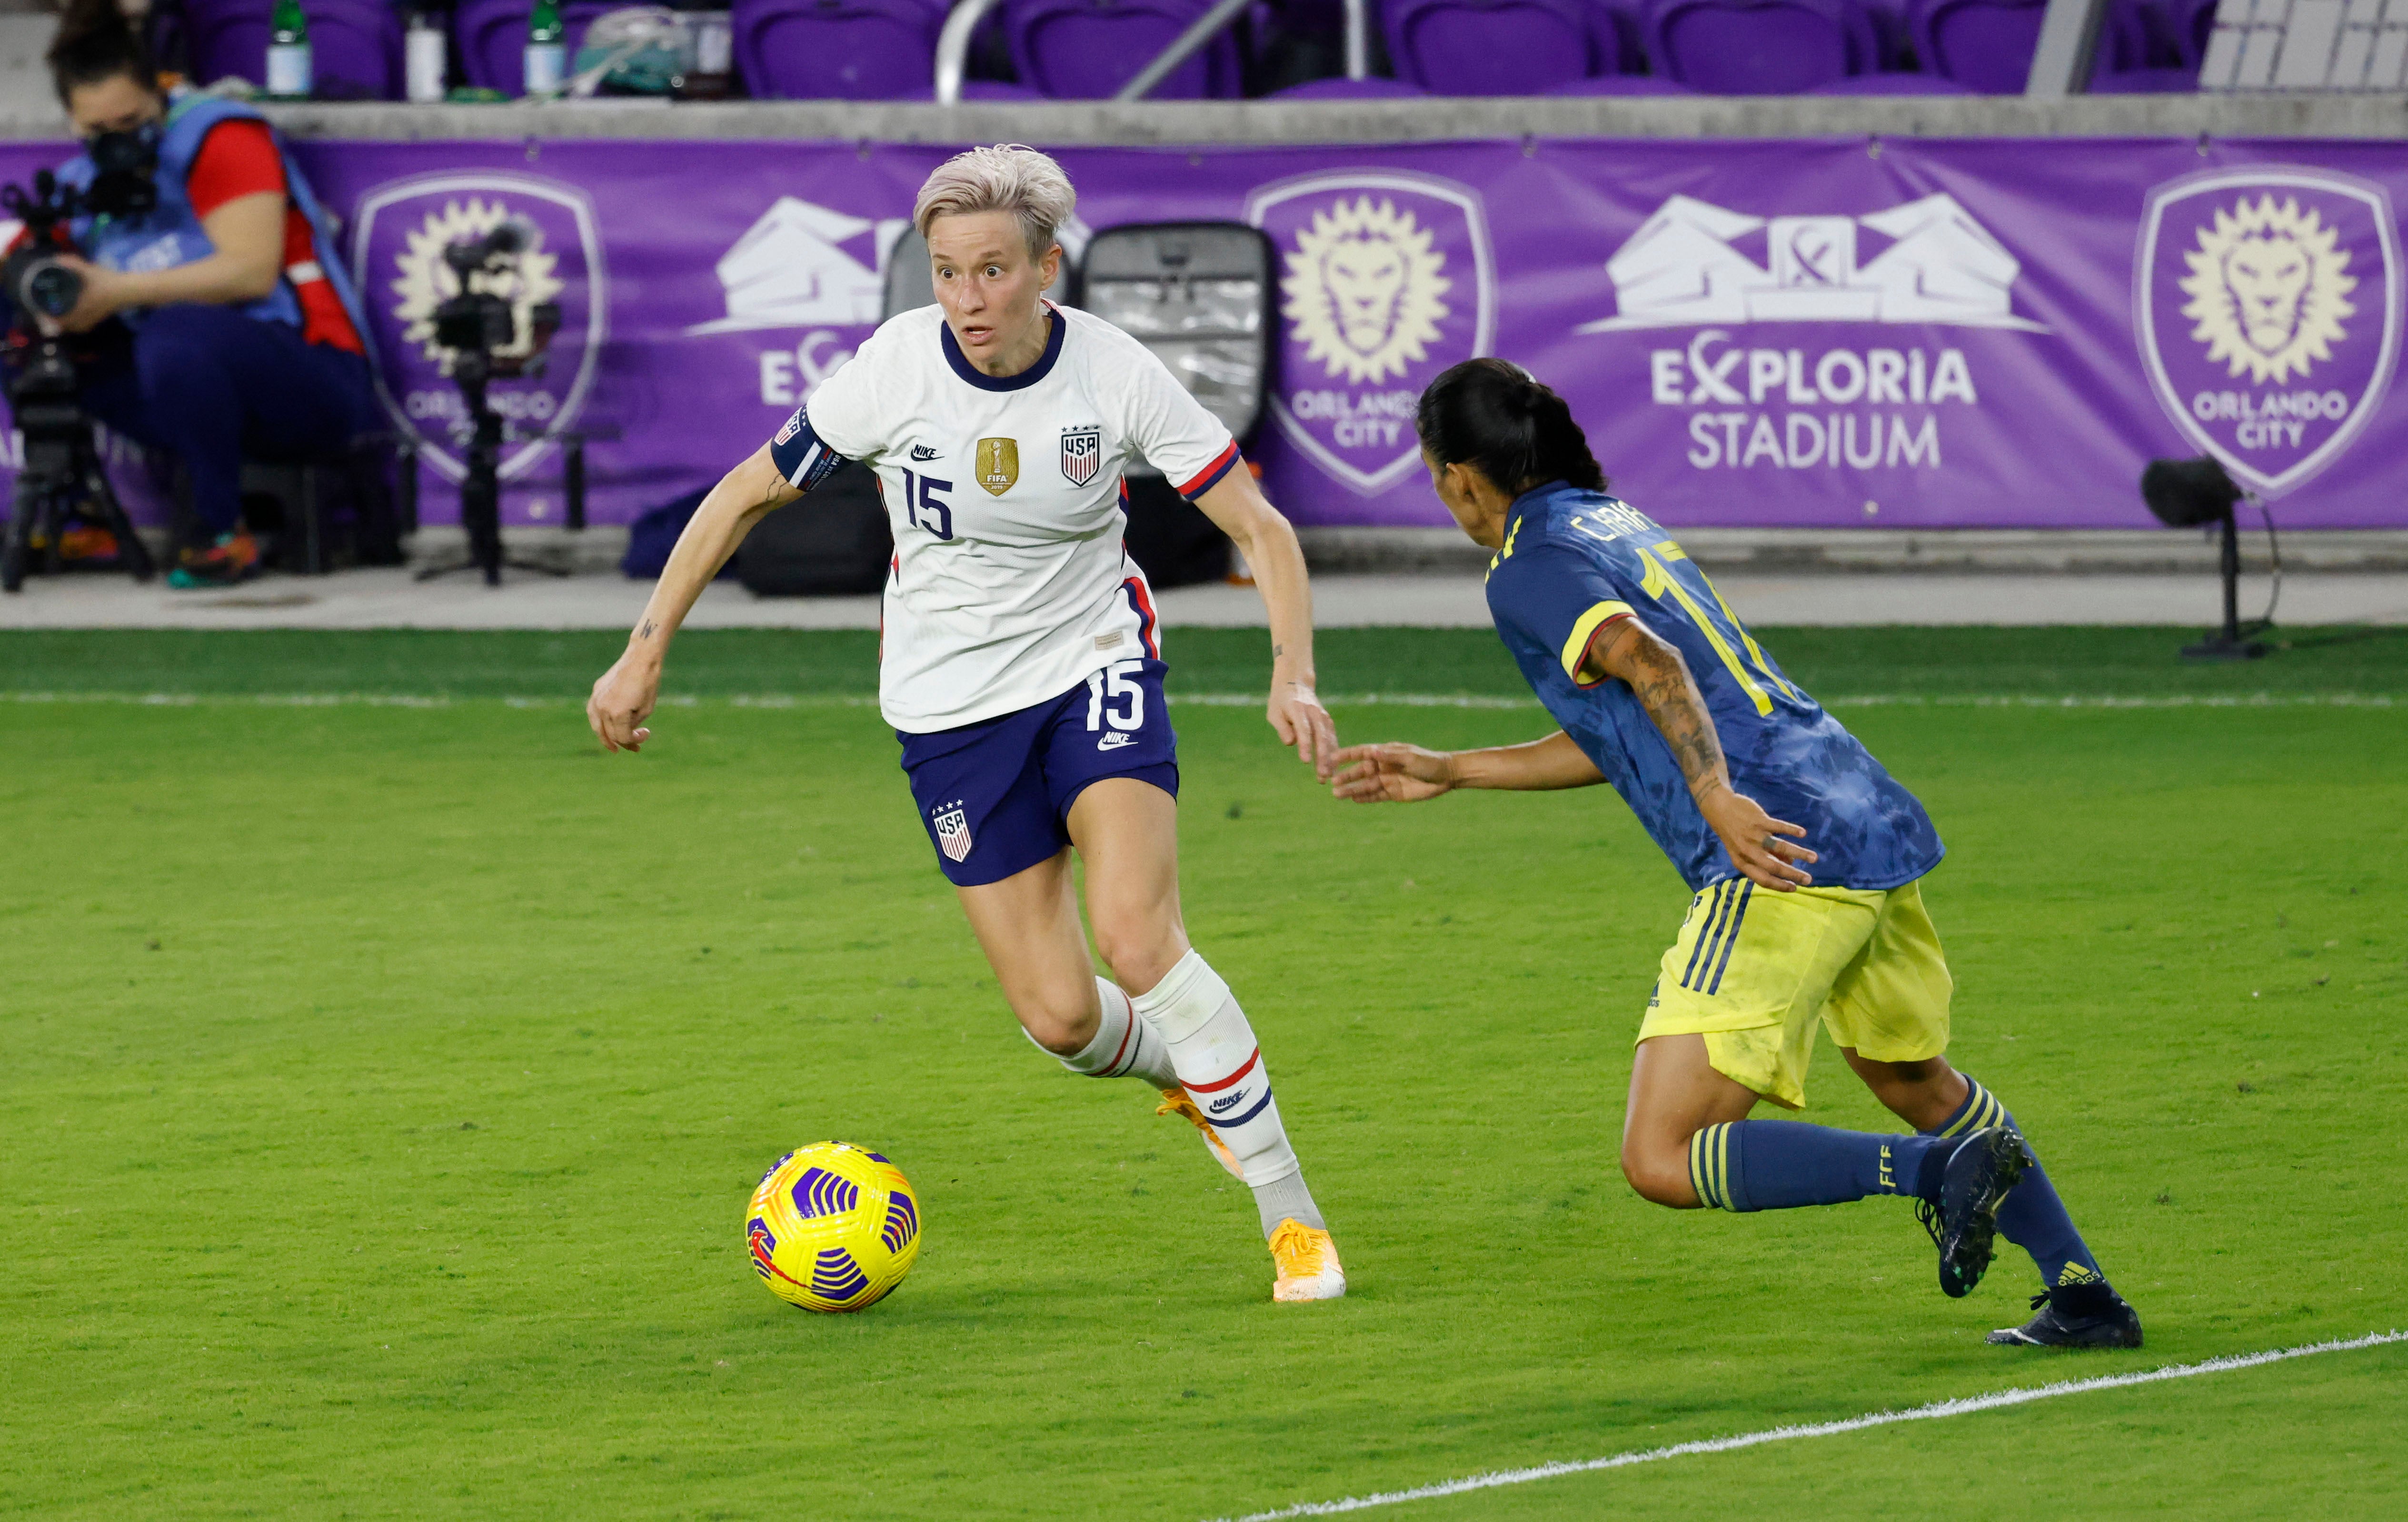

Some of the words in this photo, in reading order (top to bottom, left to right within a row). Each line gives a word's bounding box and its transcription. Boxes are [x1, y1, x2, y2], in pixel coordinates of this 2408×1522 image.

[1651, 330, 1977, 405] EXPLORIA
[406, 391, 556, 420] ORLNDO
[1292, 390, 1421, 420] ORLAND
[2193, 390, 2348, 421] ORLANDO
[1065, 436, 1095, 456] USA
[1334, 420, 1403, 447] CITY
[1688, 412, 1941, 470] STADIUM
[2237, 421, 2306, 449] CITY
[831, 455, 841, 466] USA
[914, 444, 936, 458] NIKE
[901, 466, 953, 541] 15
[1634, 540, 1798, 717] 17
[1085, 660, 1144, 731] 15
[1103, 731, 1130, 743] NIKE
[937, 812, 963, 835] USA
[1214, 1090, 1243, 1107] NIKE
[1879, 1145, 1897, 1187] FCF
